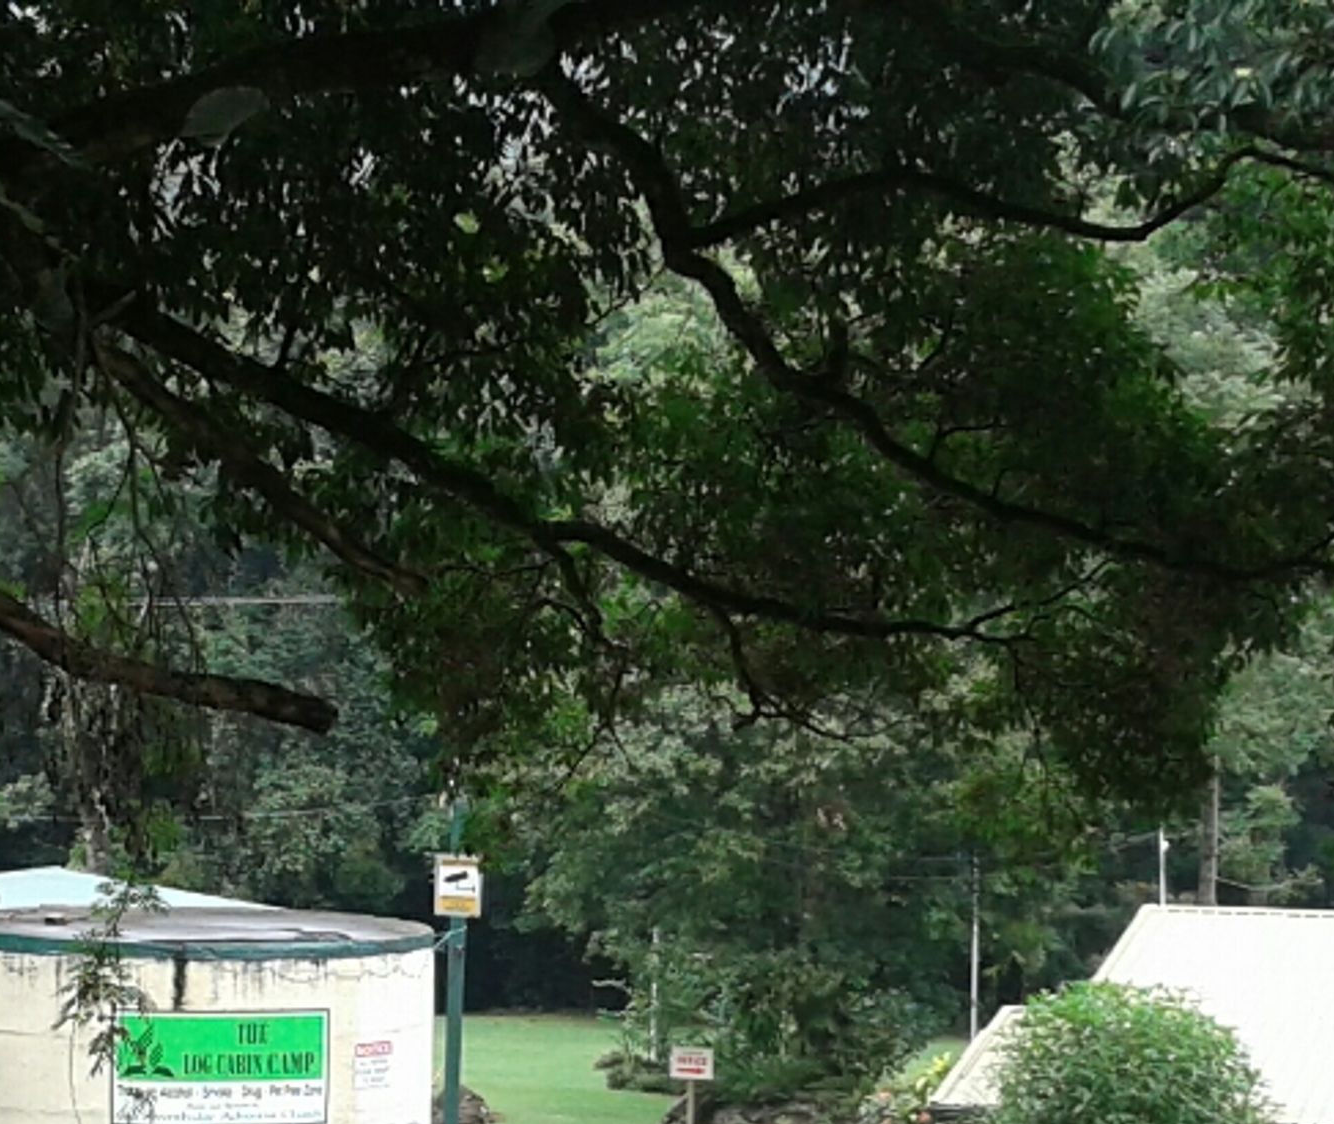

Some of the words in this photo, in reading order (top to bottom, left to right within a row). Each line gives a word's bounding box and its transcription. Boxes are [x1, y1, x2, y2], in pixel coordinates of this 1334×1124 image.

[237, 1023, 269, 1045] THE
[183, 1053, 212, 1075] LOG
[216, 1053, 263, 1075] CABIN
[267, 1051, 315, 1075] CAMP
